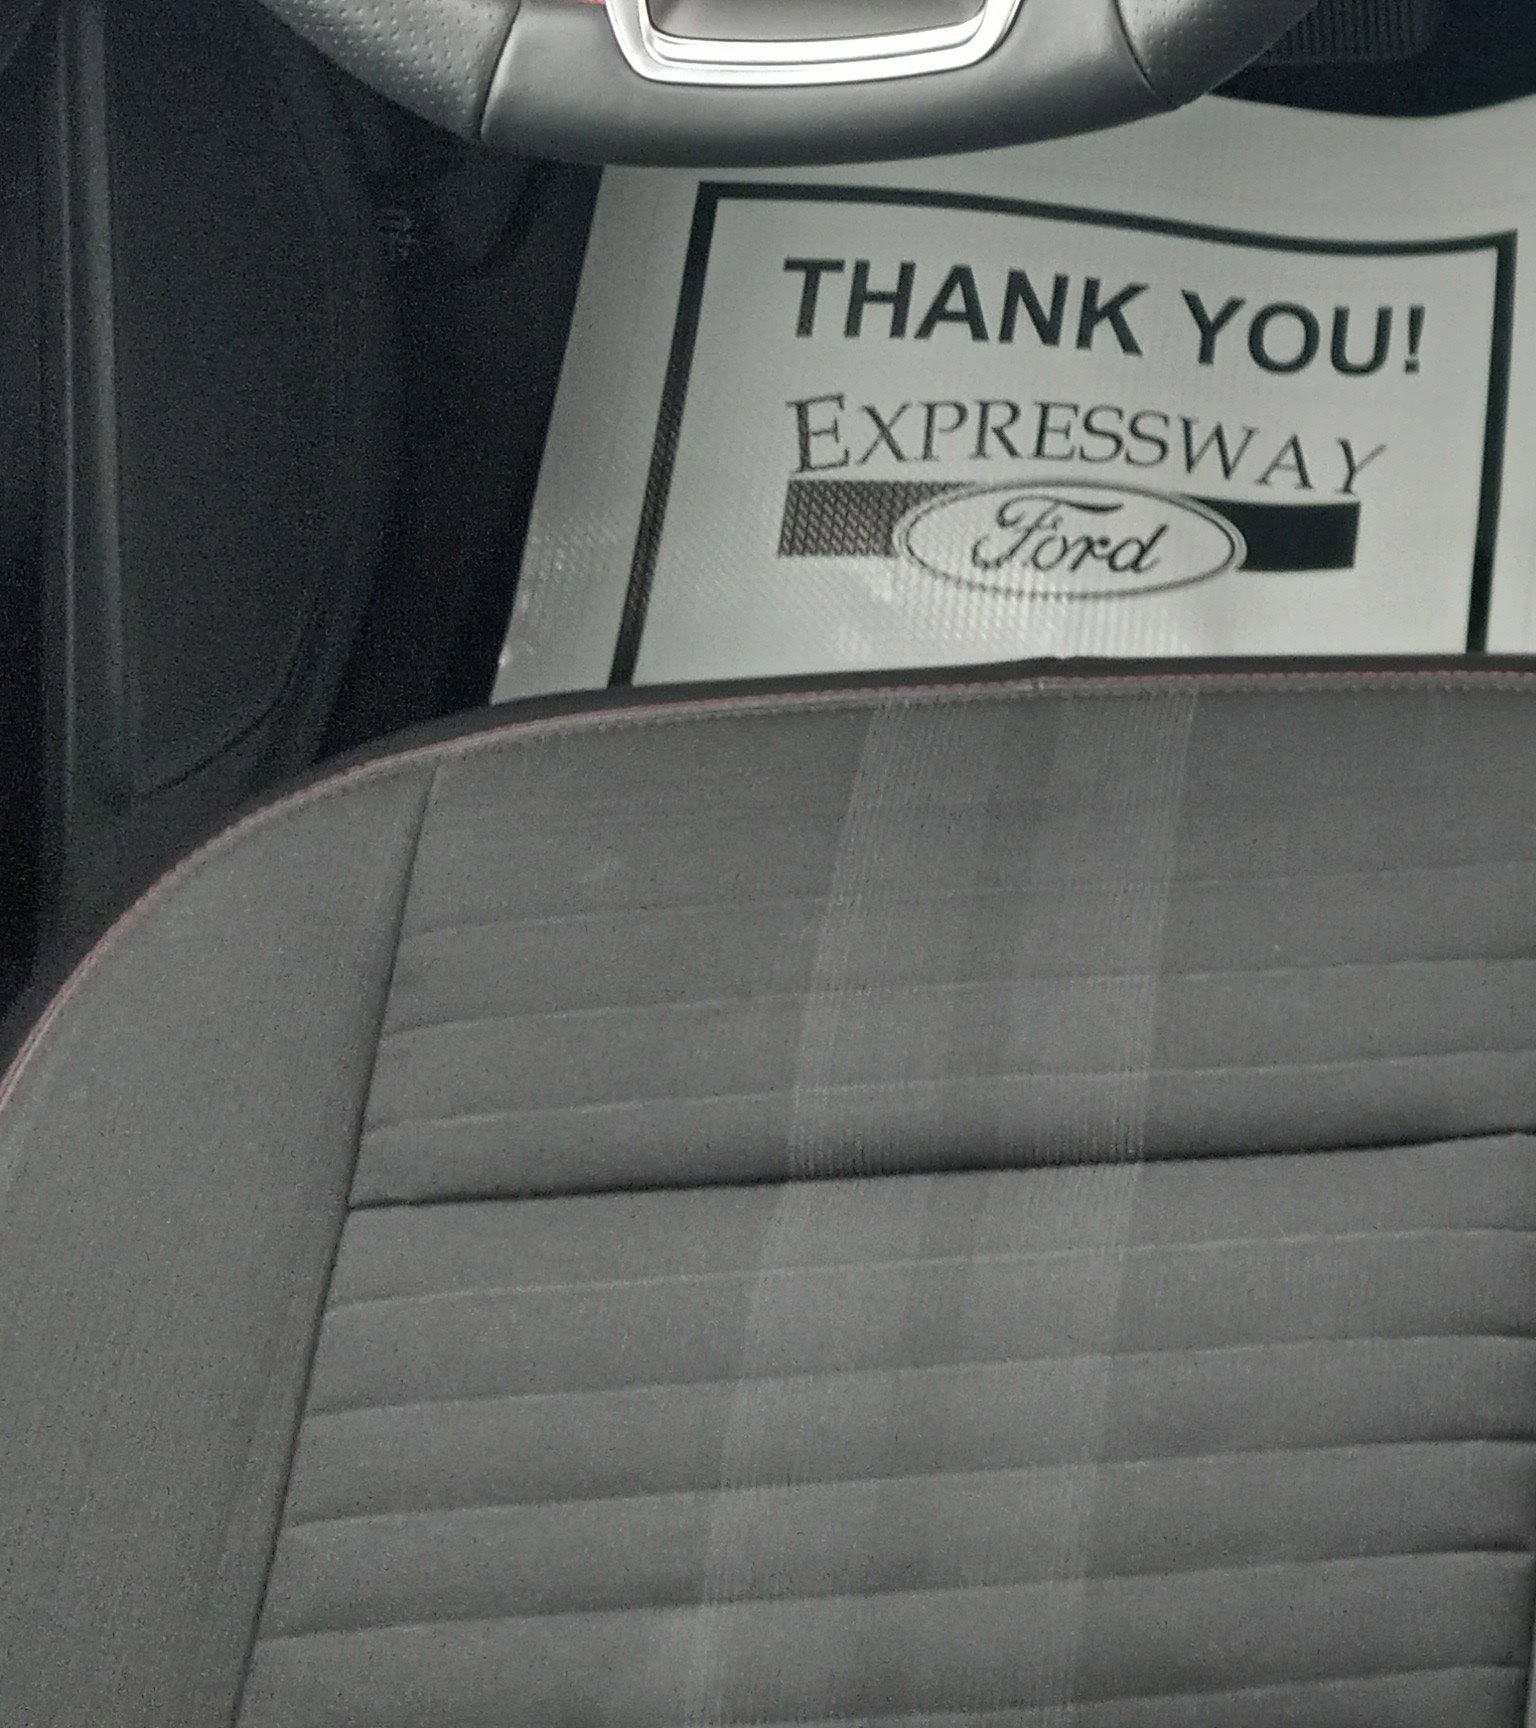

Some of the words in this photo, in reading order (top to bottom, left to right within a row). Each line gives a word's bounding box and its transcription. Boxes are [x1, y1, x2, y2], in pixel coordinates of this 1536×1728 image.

[784, 256, 1149, 358] THANK
[1180, 287, 1427, 375] YOU!
[784, 392, 1388, 496] EXPRESSWAY
[971, 493, 1170, 574] Ford
